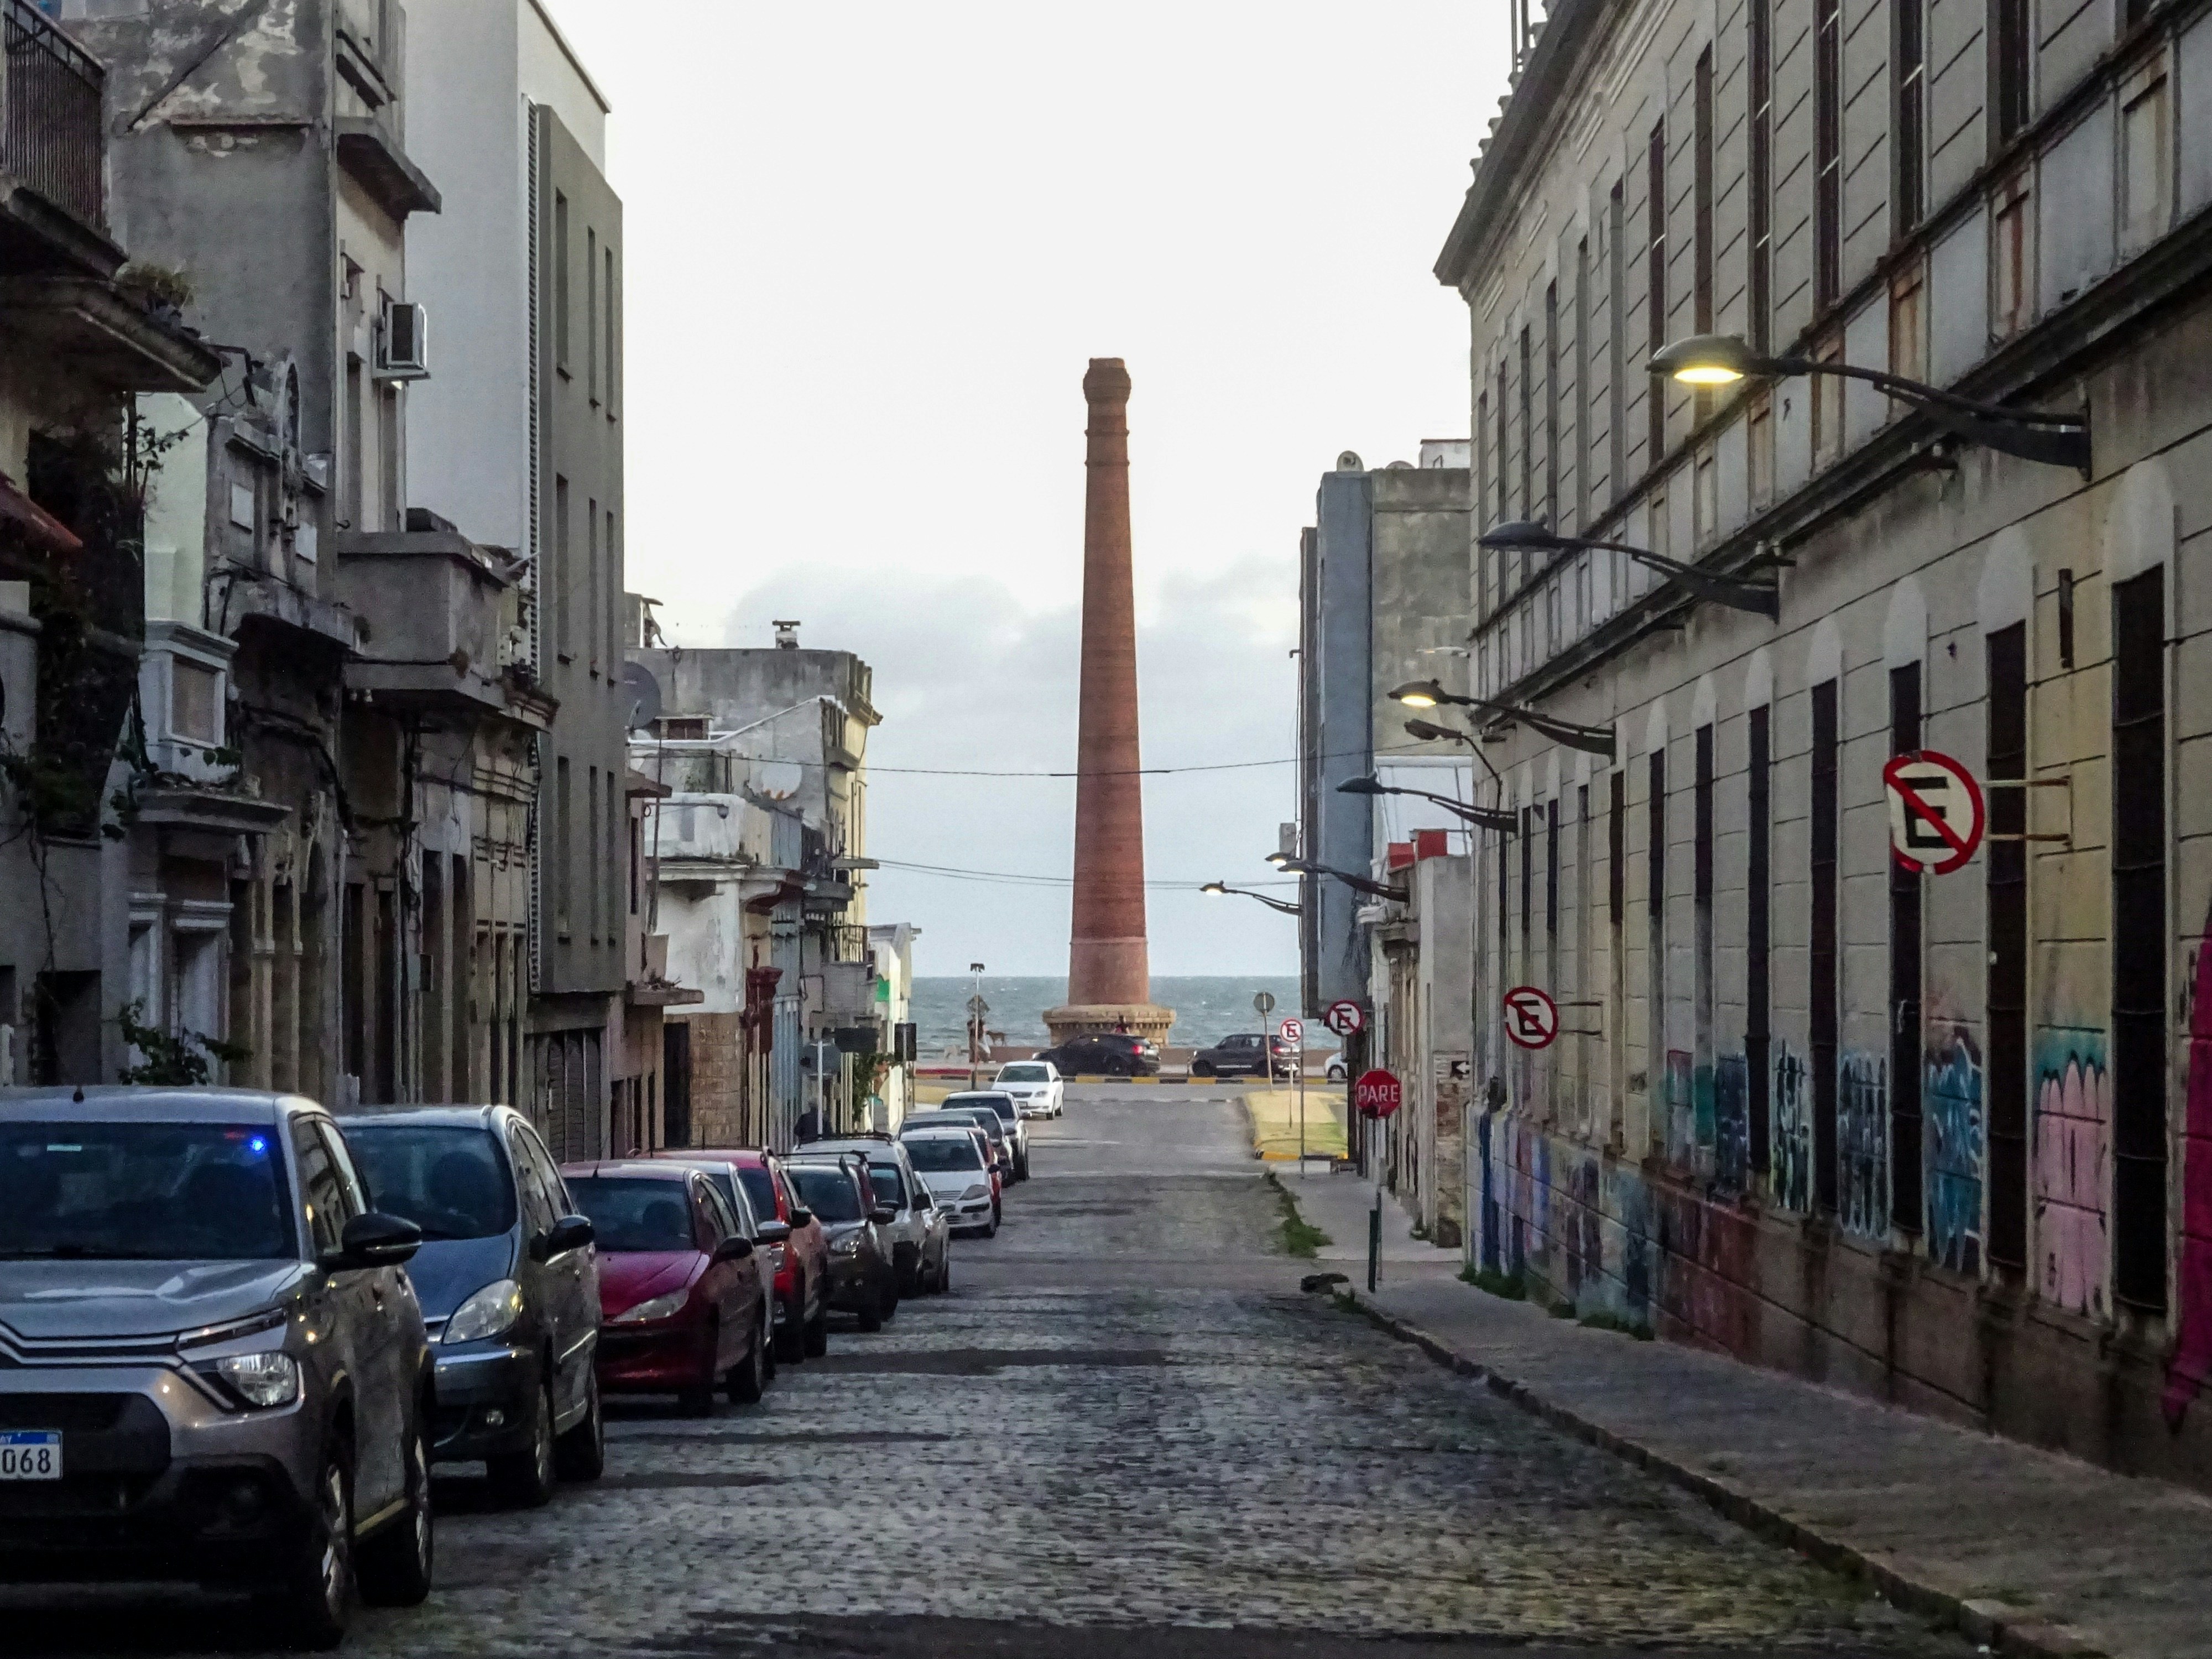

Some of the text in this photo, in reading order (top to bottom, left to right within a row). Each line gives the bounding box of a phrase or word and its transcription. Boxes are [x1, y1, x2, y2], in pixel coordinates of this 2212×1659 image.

[1900, 776, 1952, 848] E
[1515, 1000, 1542, 1036] E
[1358, 1084, 1399, 1103] PARE
[2, 1448, 50, 1474] 068
